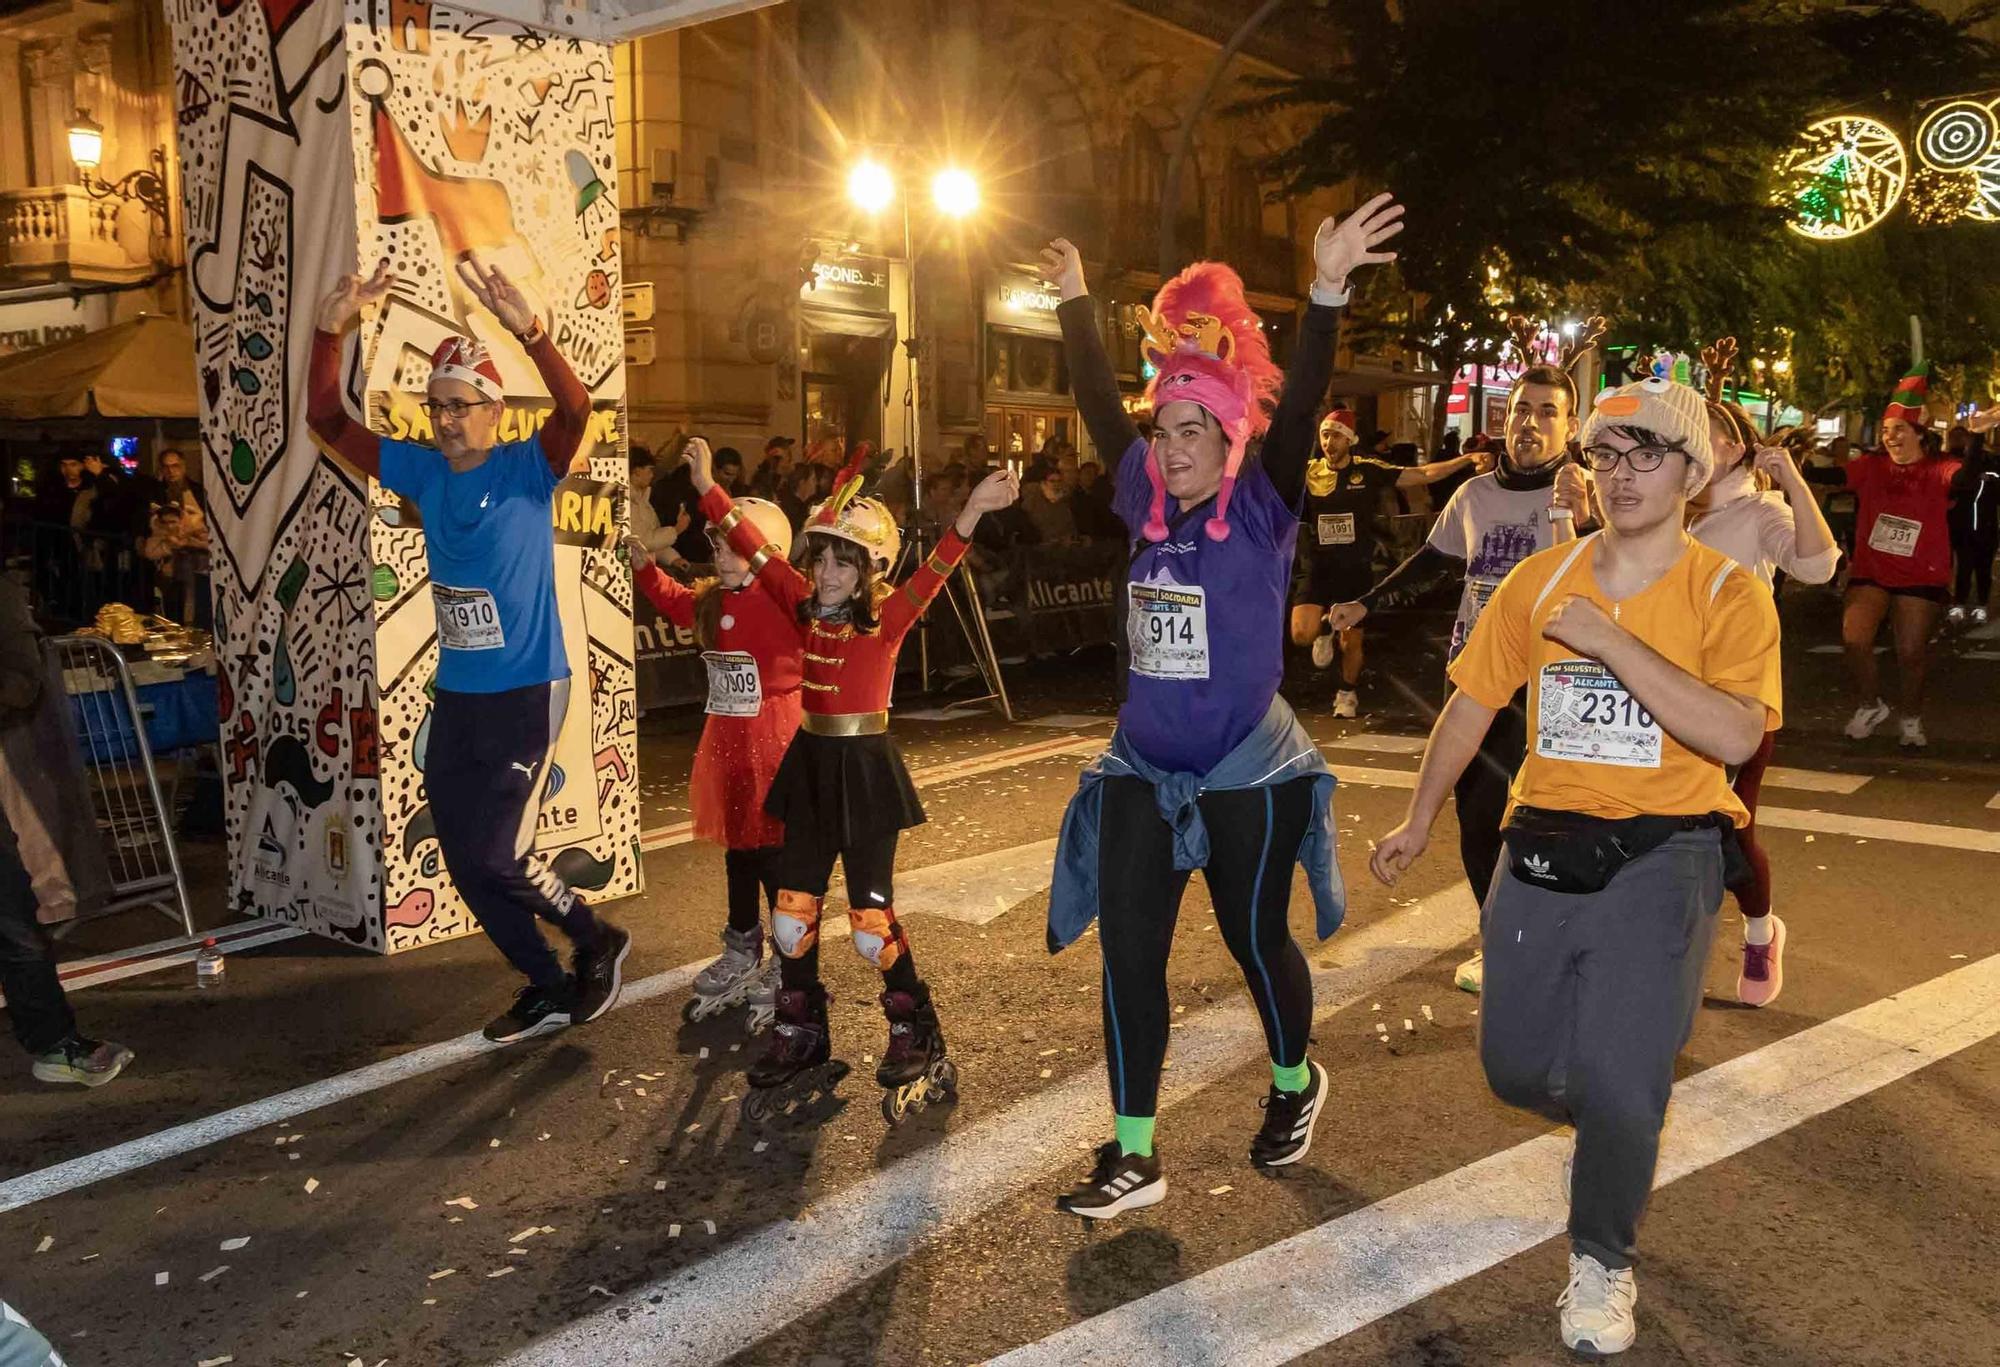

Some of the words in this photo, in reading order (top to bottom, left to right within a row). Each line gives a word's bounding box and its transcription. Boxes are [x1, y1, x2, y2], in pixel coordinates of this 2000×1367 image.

[556, 323, 599, 368] RUN
[1890, 529, 1911, 542] 331
[449, 603, 493, 627] 1910
[1150, 616, 1194, 645] 914
[1574, 678, 1619, 689] ALICANTE
[254, 863, 291, 886] Alicante
